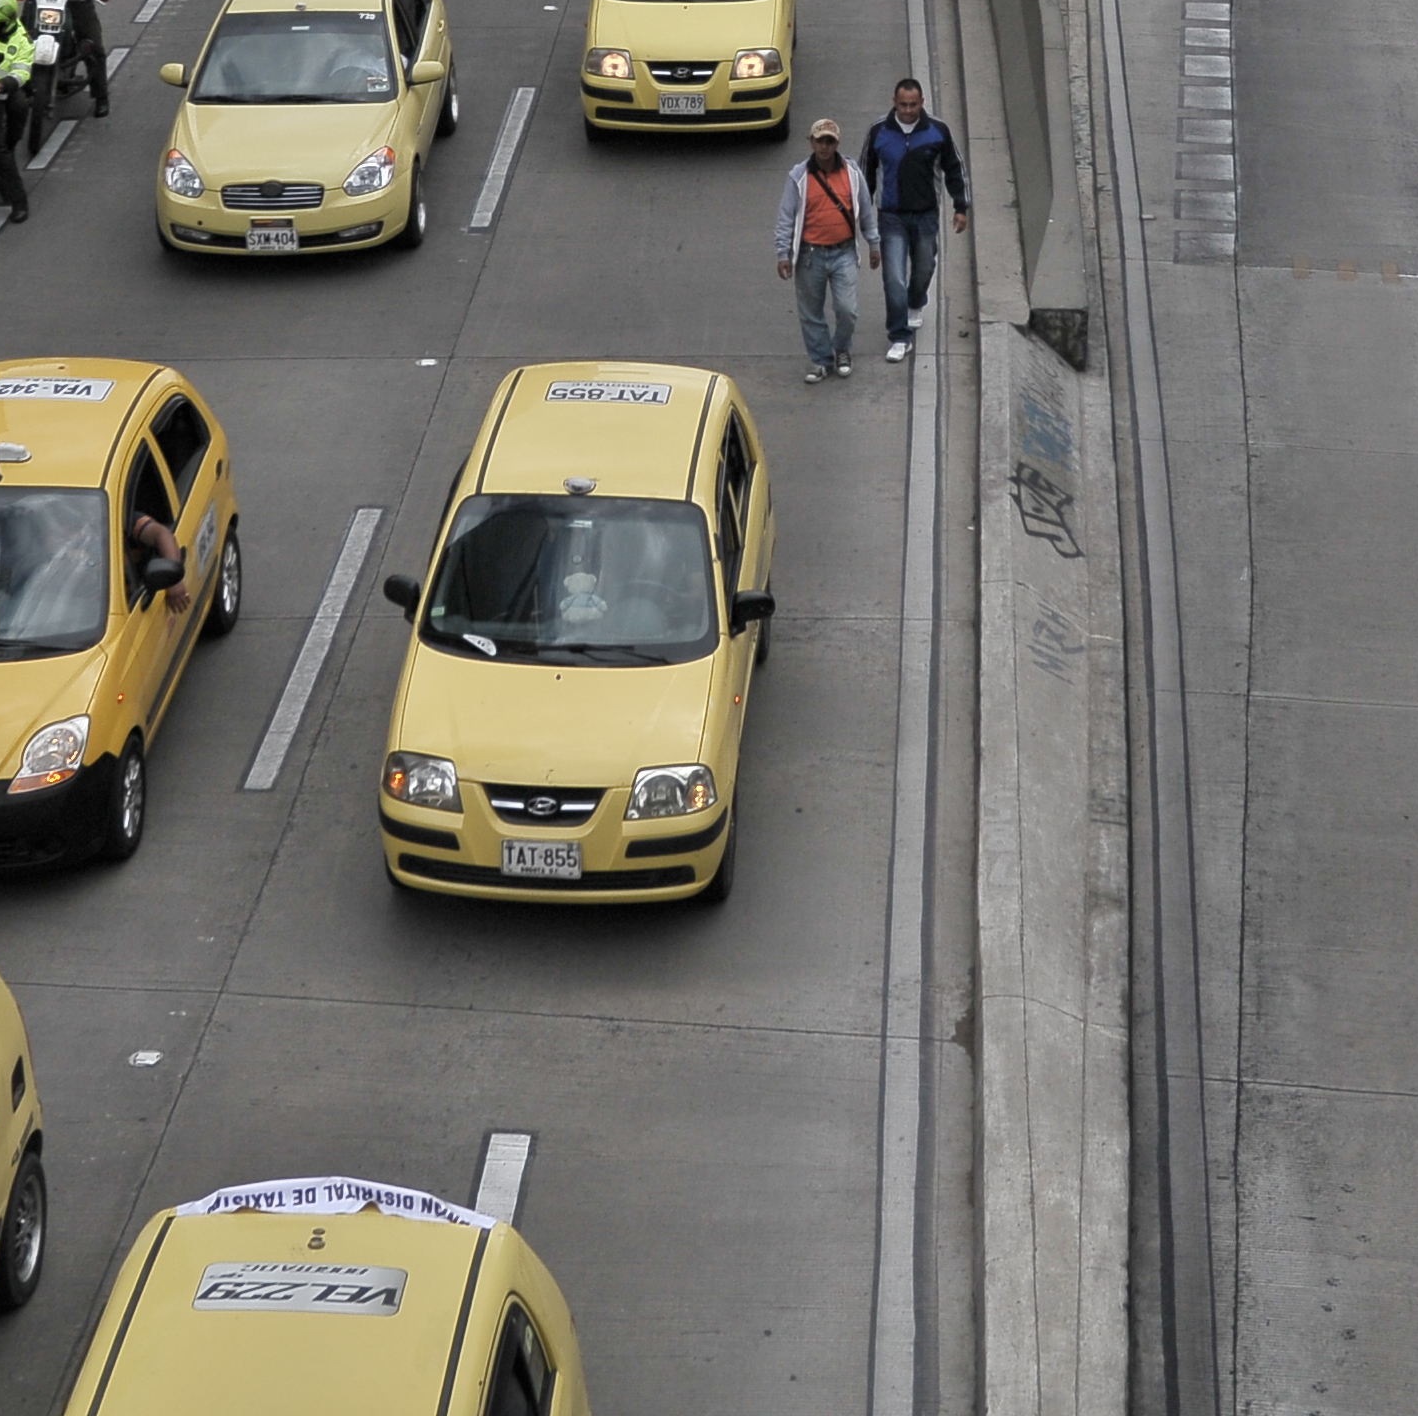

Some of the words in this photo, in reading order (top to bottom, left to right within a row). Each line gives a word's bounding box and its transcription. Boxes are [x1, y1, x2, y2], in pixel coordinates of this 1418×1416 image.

[248, 232, 297, 246] SXM-404
[292, 1186, 316, 1206] DE
[322, 1183, 415, 1211] DISTRITAL
[196, 1281, 301, 1303] 229
[312, 1284, 399, 1307] VEL
